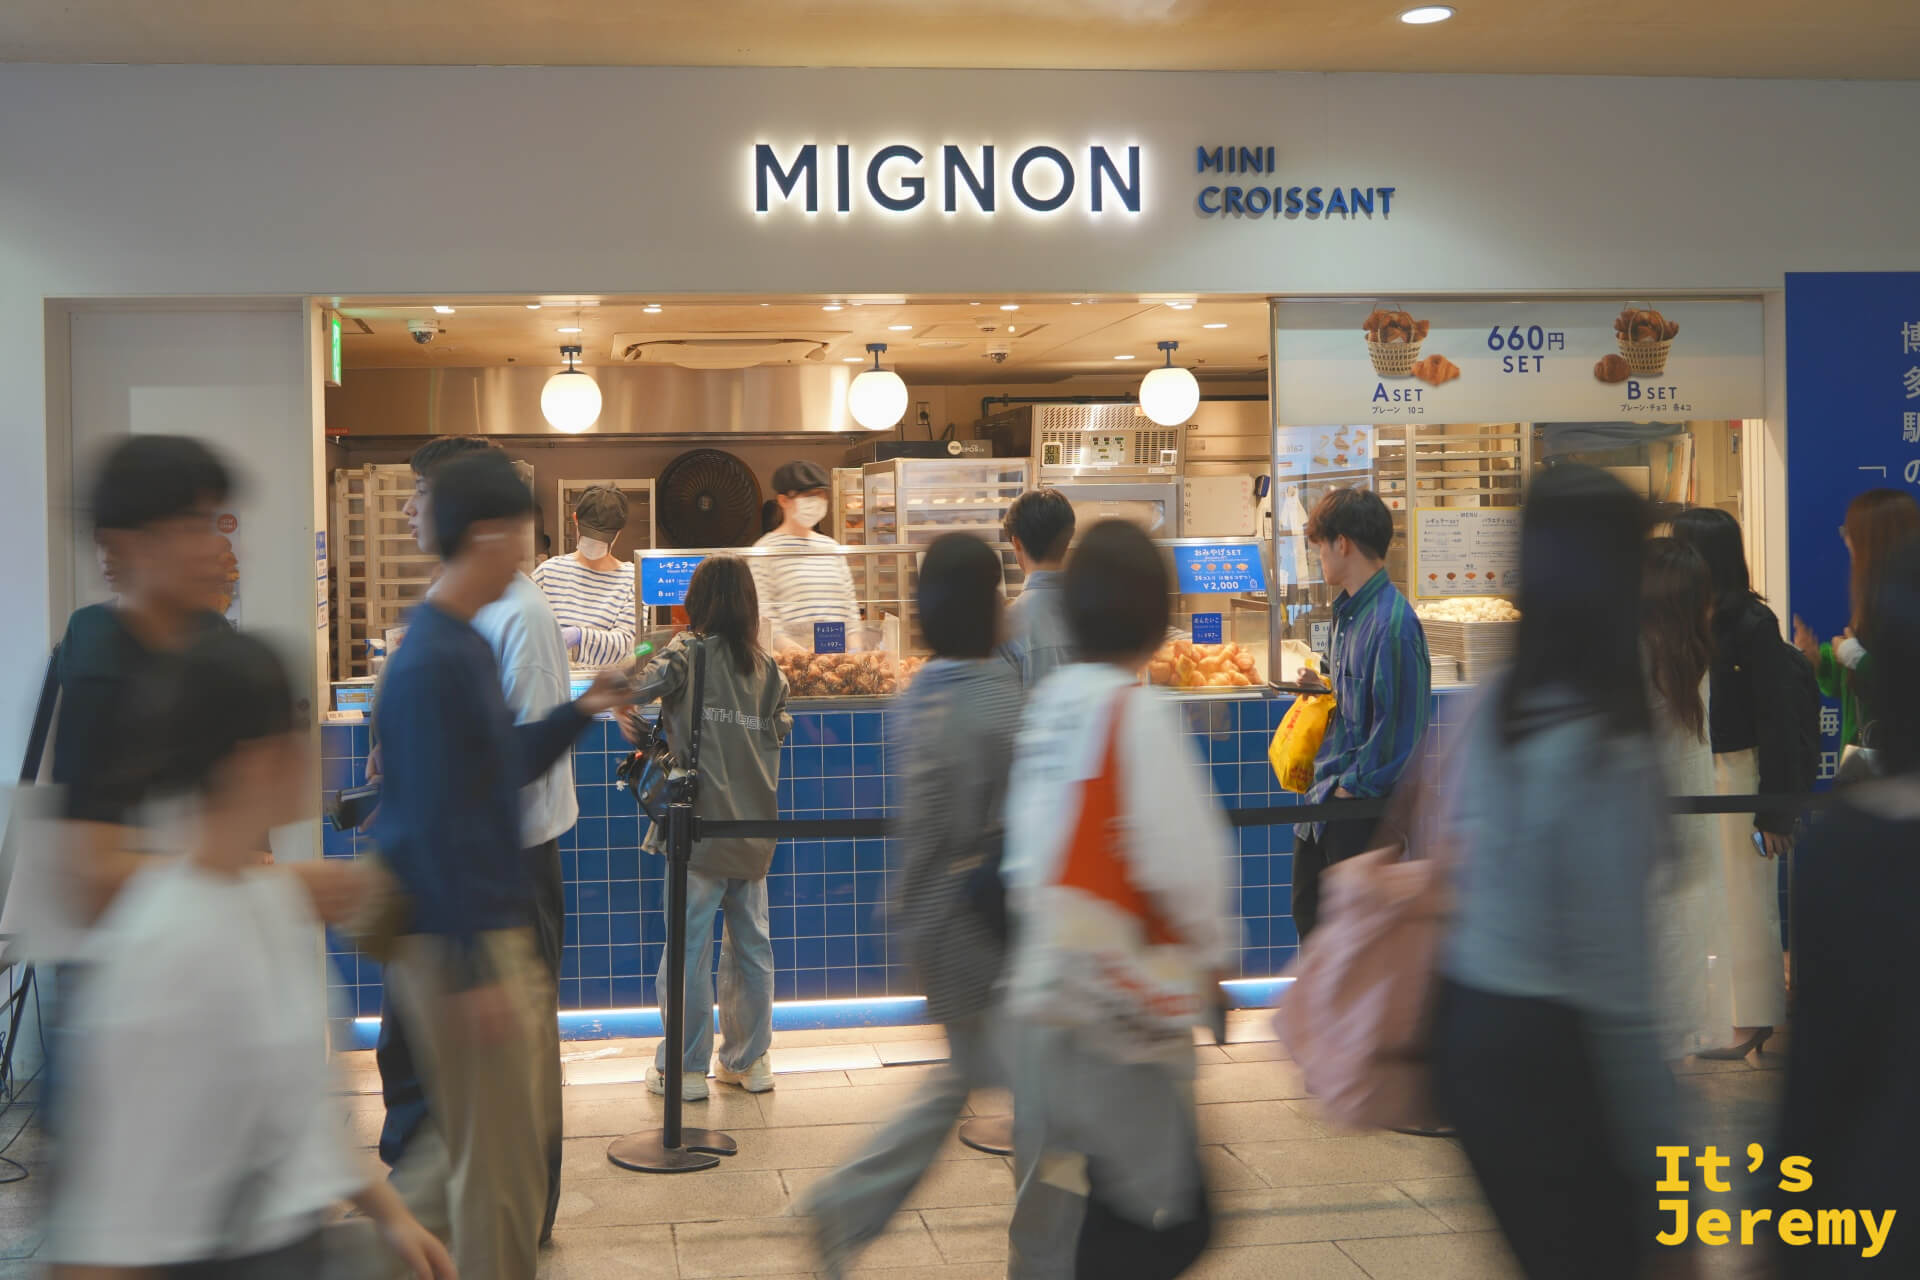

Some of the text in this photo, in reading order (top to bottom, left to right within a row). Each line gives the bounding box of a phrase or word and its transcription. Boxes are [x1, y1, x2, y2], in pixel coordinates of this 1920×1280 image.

[1196, 146, 1275, 174] MINI
[754, 143, 1142, 213] MIGNON
[1197, 186, 1396, 217] CROISSANT
[1487, 325, 1565, 351] 660円
[1503, 355, 1545, 373] SET
[1371, 382, 1424, 402] A SET
[1627, 380, 1678, 400] B SET
[1202, 581, 1240, 591] ¥2,000
